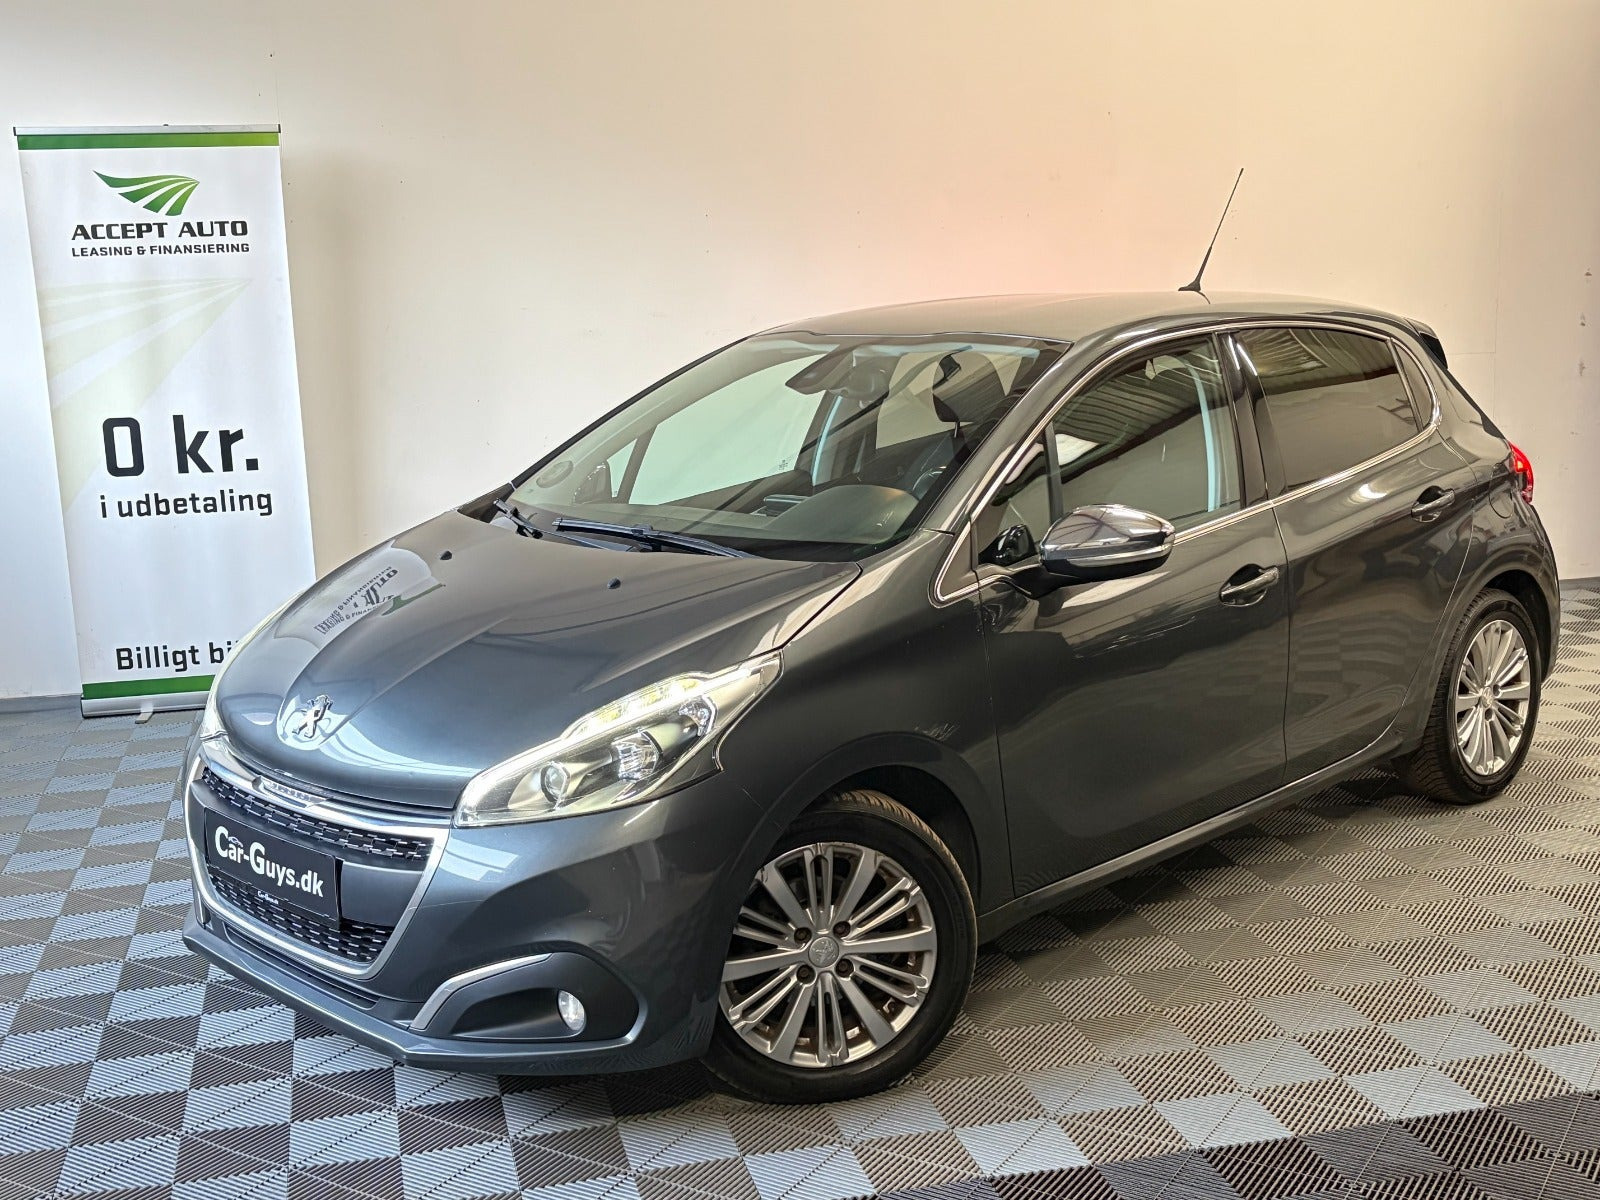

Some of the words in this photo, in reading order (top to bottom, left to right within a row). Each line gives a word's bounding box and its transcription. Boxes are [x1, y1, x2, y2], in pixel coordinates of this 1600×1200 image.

[71, 223, 168, 240] ACCEPT
[178, 220, 248, 238] AUTO
[72, 246, 133, 257] LEASING
[137, 246, 146, 255] &
[150, 243, 250, 255] FINANSIERING
[102, 417, 144, 477] 0
[172, 414, 259, 474] kr.
[100, 495, 107, 518] i
[117, 488, 273, 518] udbetaling
[116, 644, 200, 672] Billigt
[214, 825, 324, 898] Car-Guys.dk
